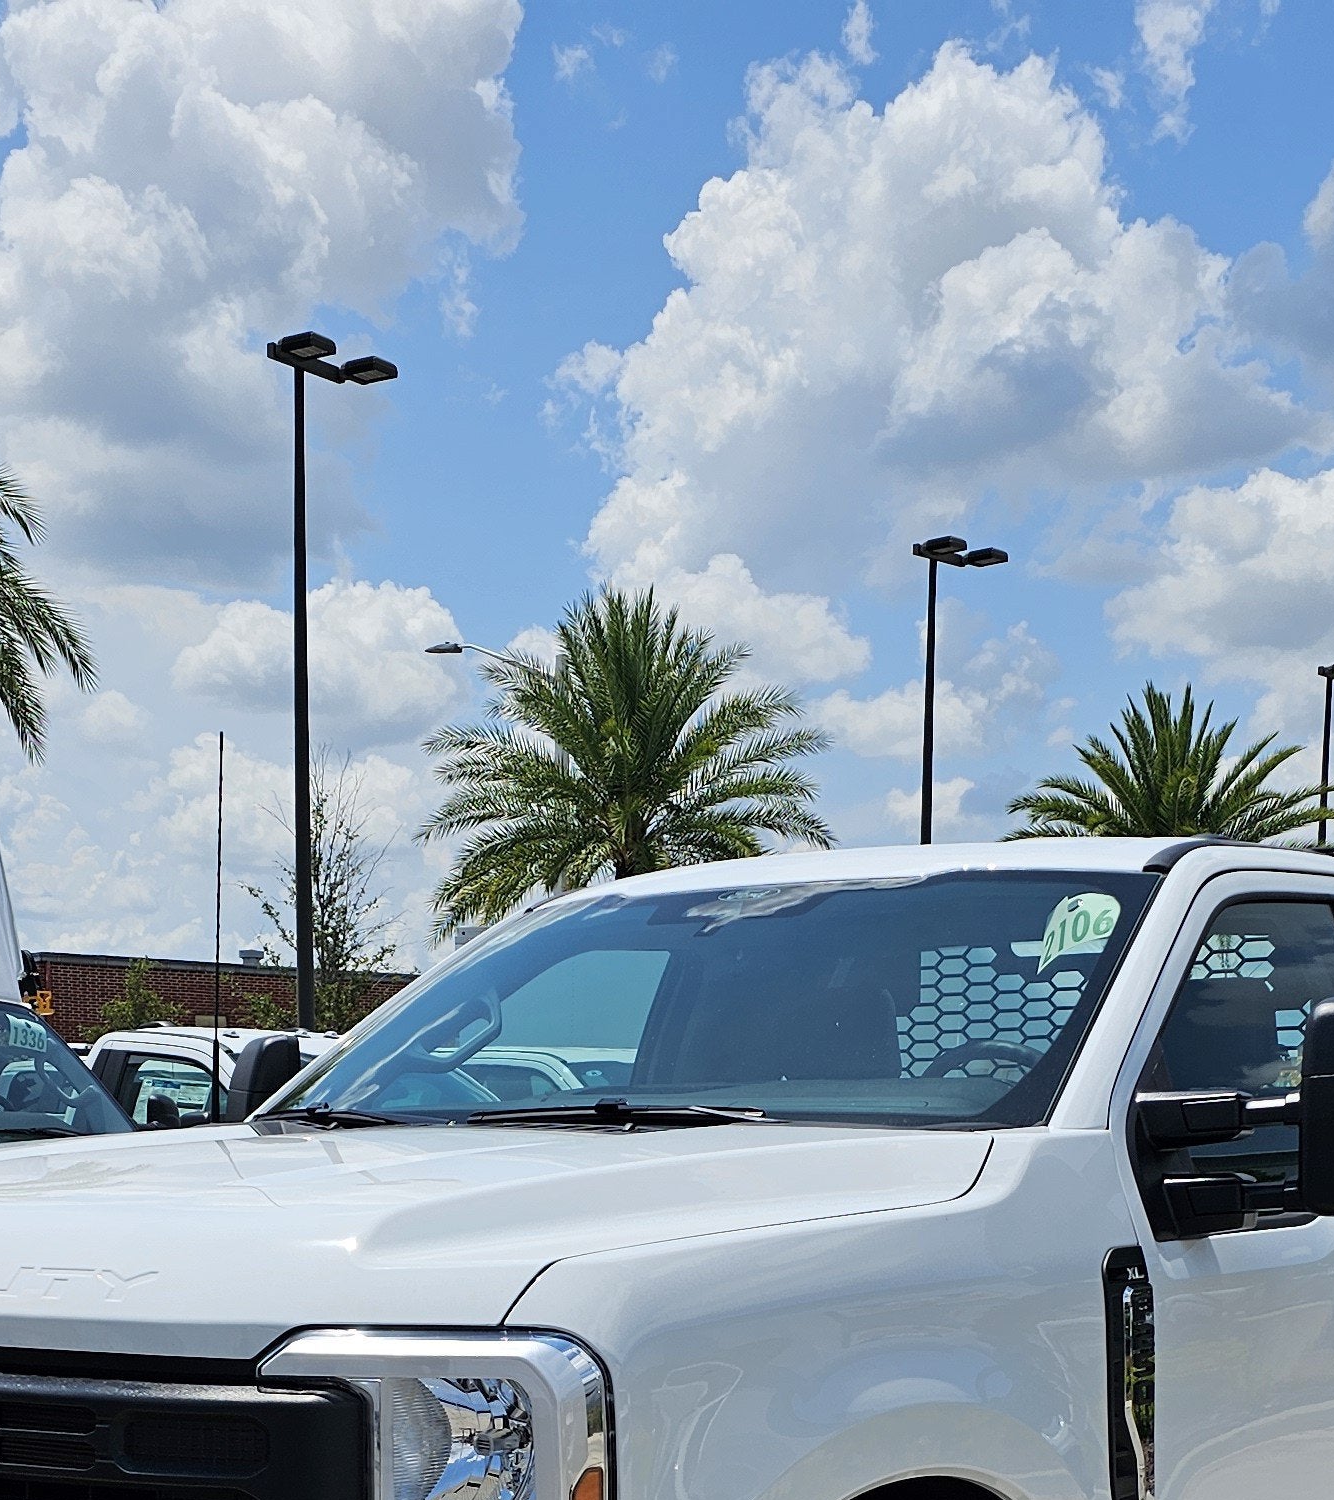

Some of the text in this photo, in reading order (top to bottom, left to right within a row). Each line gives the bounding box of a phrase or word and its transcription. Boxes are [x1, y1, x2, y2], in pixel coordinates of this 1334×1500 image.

[1040, 909, 1115, 968] 2106
[13, 1026, 45, 1050] 1336
[1126, 1266, 1146, 1282] XL
